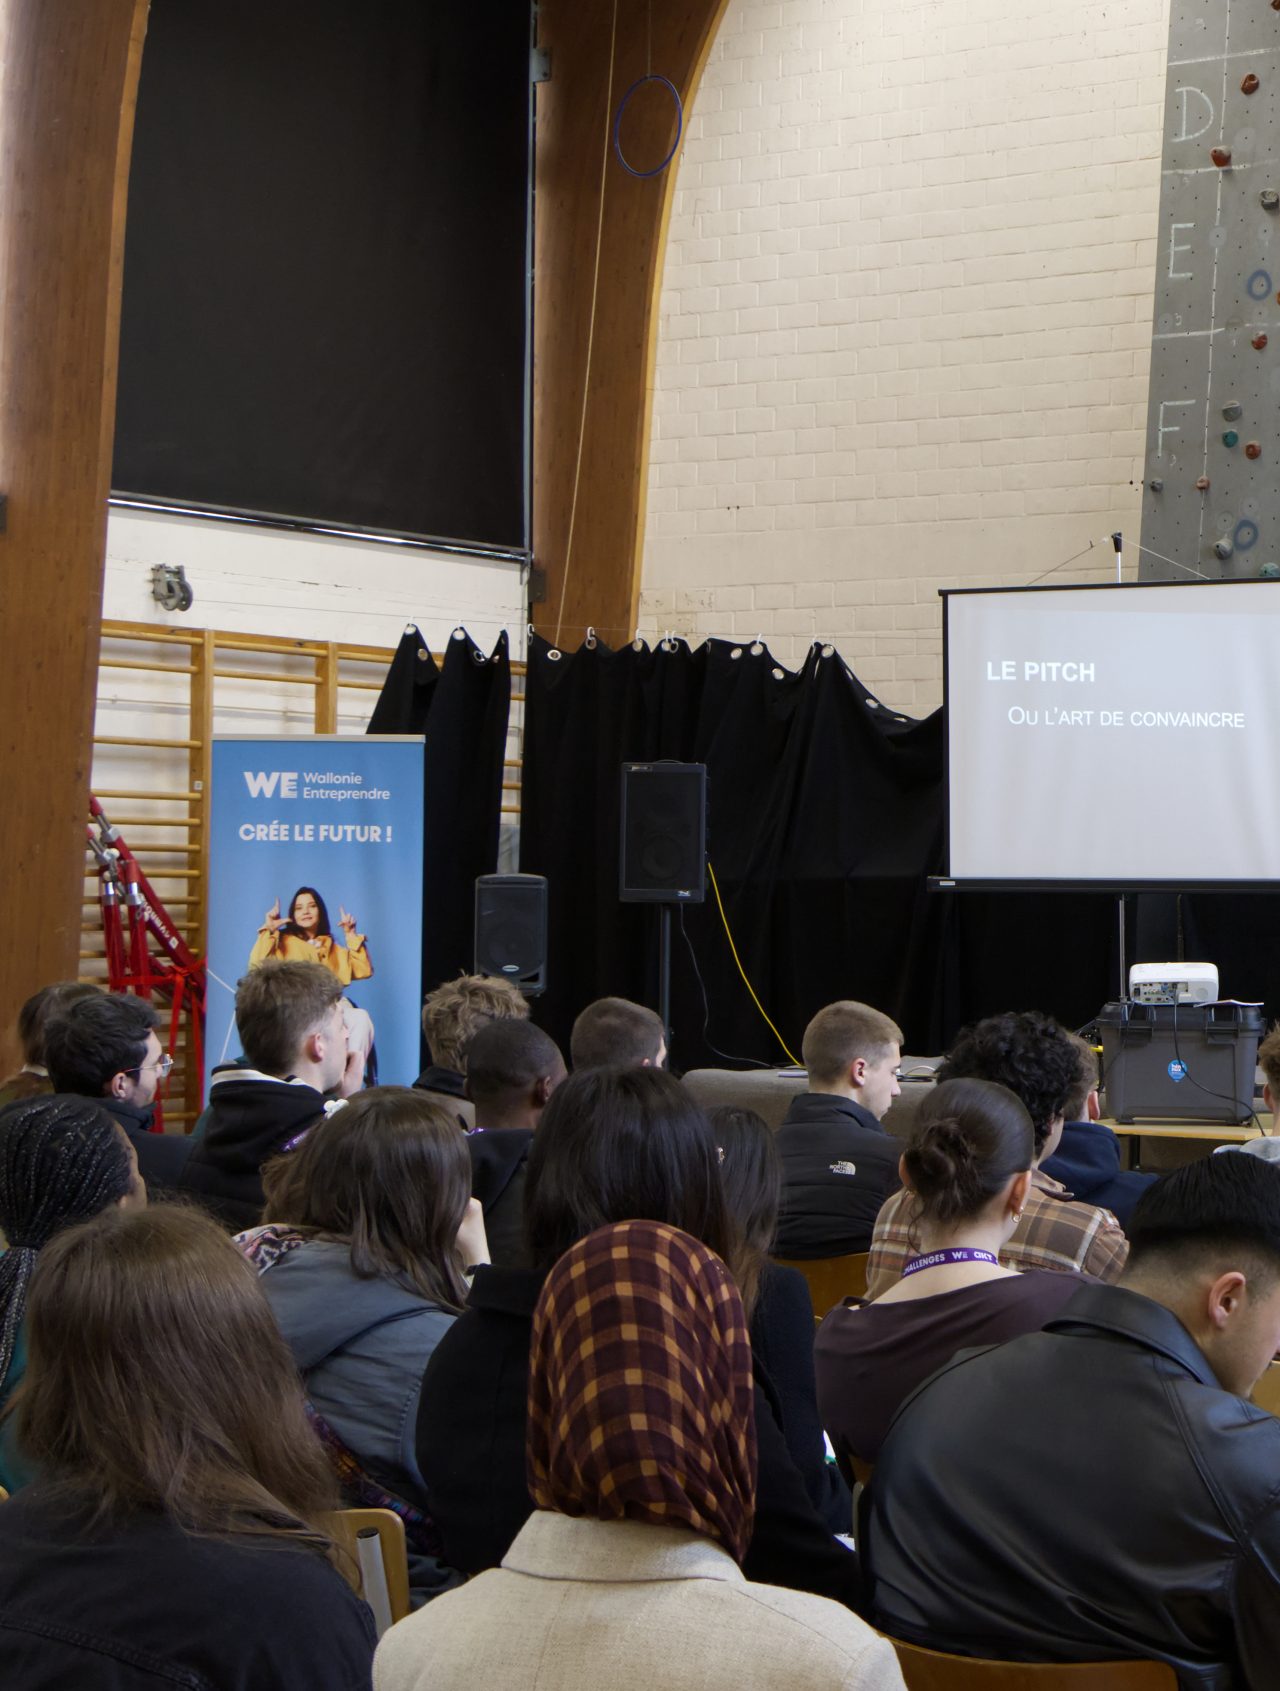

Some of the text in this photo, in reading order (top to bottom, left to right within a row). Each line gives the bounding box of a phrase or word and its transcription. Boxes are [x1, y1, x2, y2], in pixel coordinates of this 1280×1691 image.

[1172, 86, 1215, 143] D
[1168, 222, 1196, 280] E
[1158, 399, 1197, 457] F
[986, 660, 1096, 682] LE PITCH
[1100, 711, 1125, 726] DE
[1130, 710, 1246, 728] CONVAINCRE
[243, 771, 298, 799] WE
[303, 772, 363, 785] Wallonie
[303, 787, 391, 802] Entreprendre
[239, 820, 290, 842] CRÉE
[294, 824, 315, 842] LE
[319, 825, 382, 843] FUTUR
[951, 1251, 969, 1260] WE
